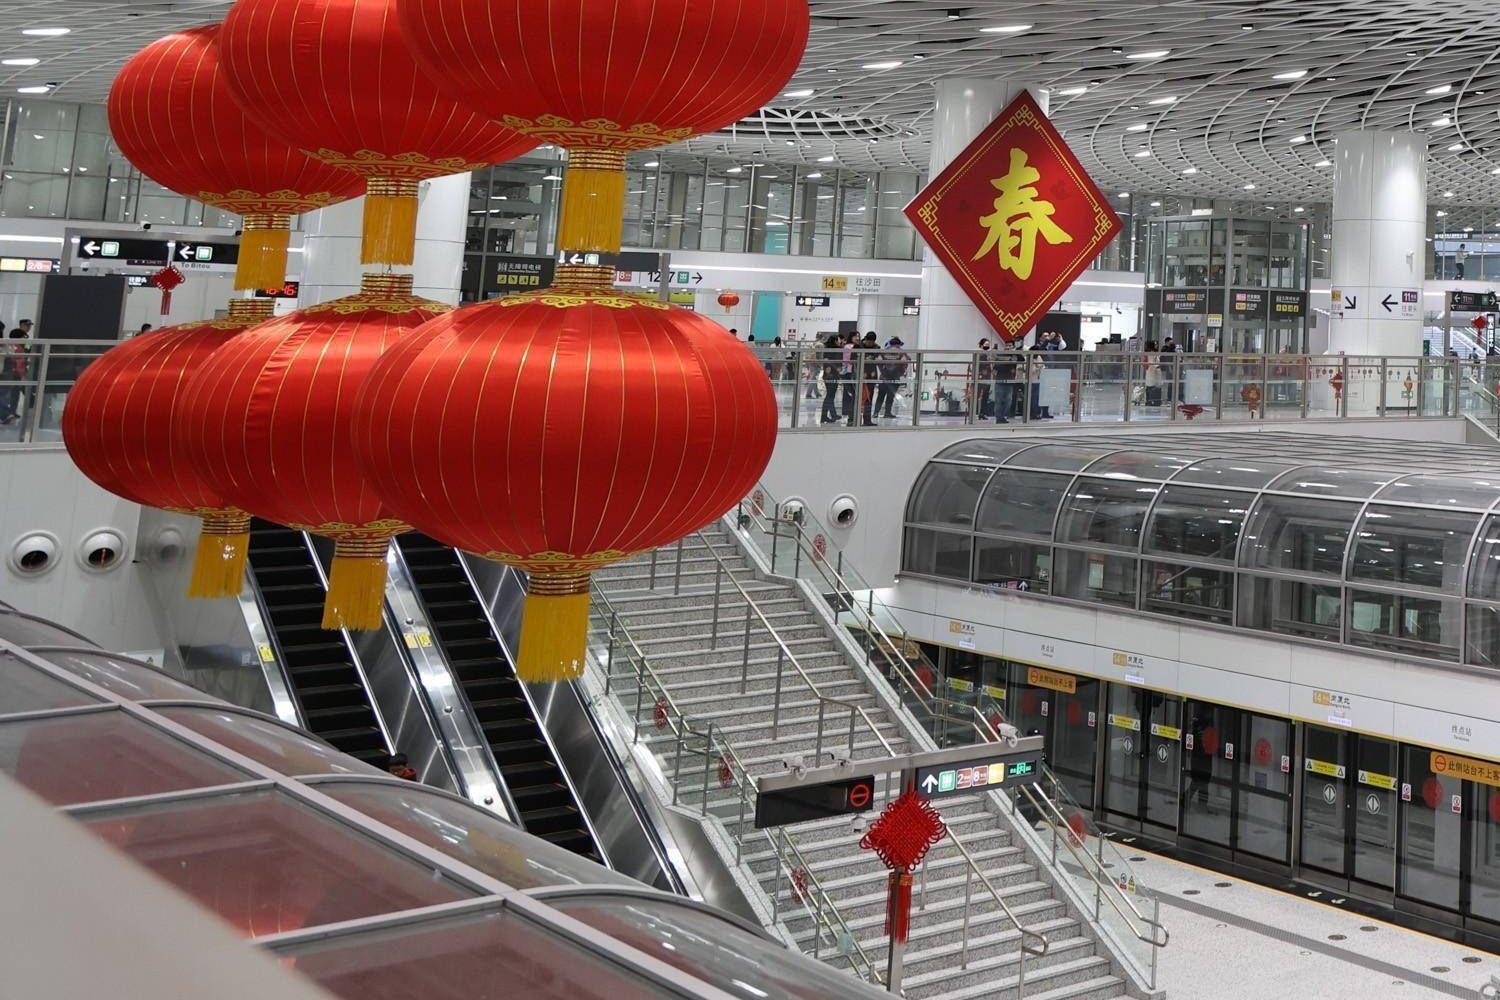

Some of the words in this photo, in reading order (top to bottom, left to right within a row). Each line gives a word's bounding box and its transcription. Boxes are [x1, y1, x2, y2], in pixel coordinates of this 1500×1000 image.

[969, 147, 1073, 281] 春
[1448, 760, 1500, 781] 此侧站台不上客
